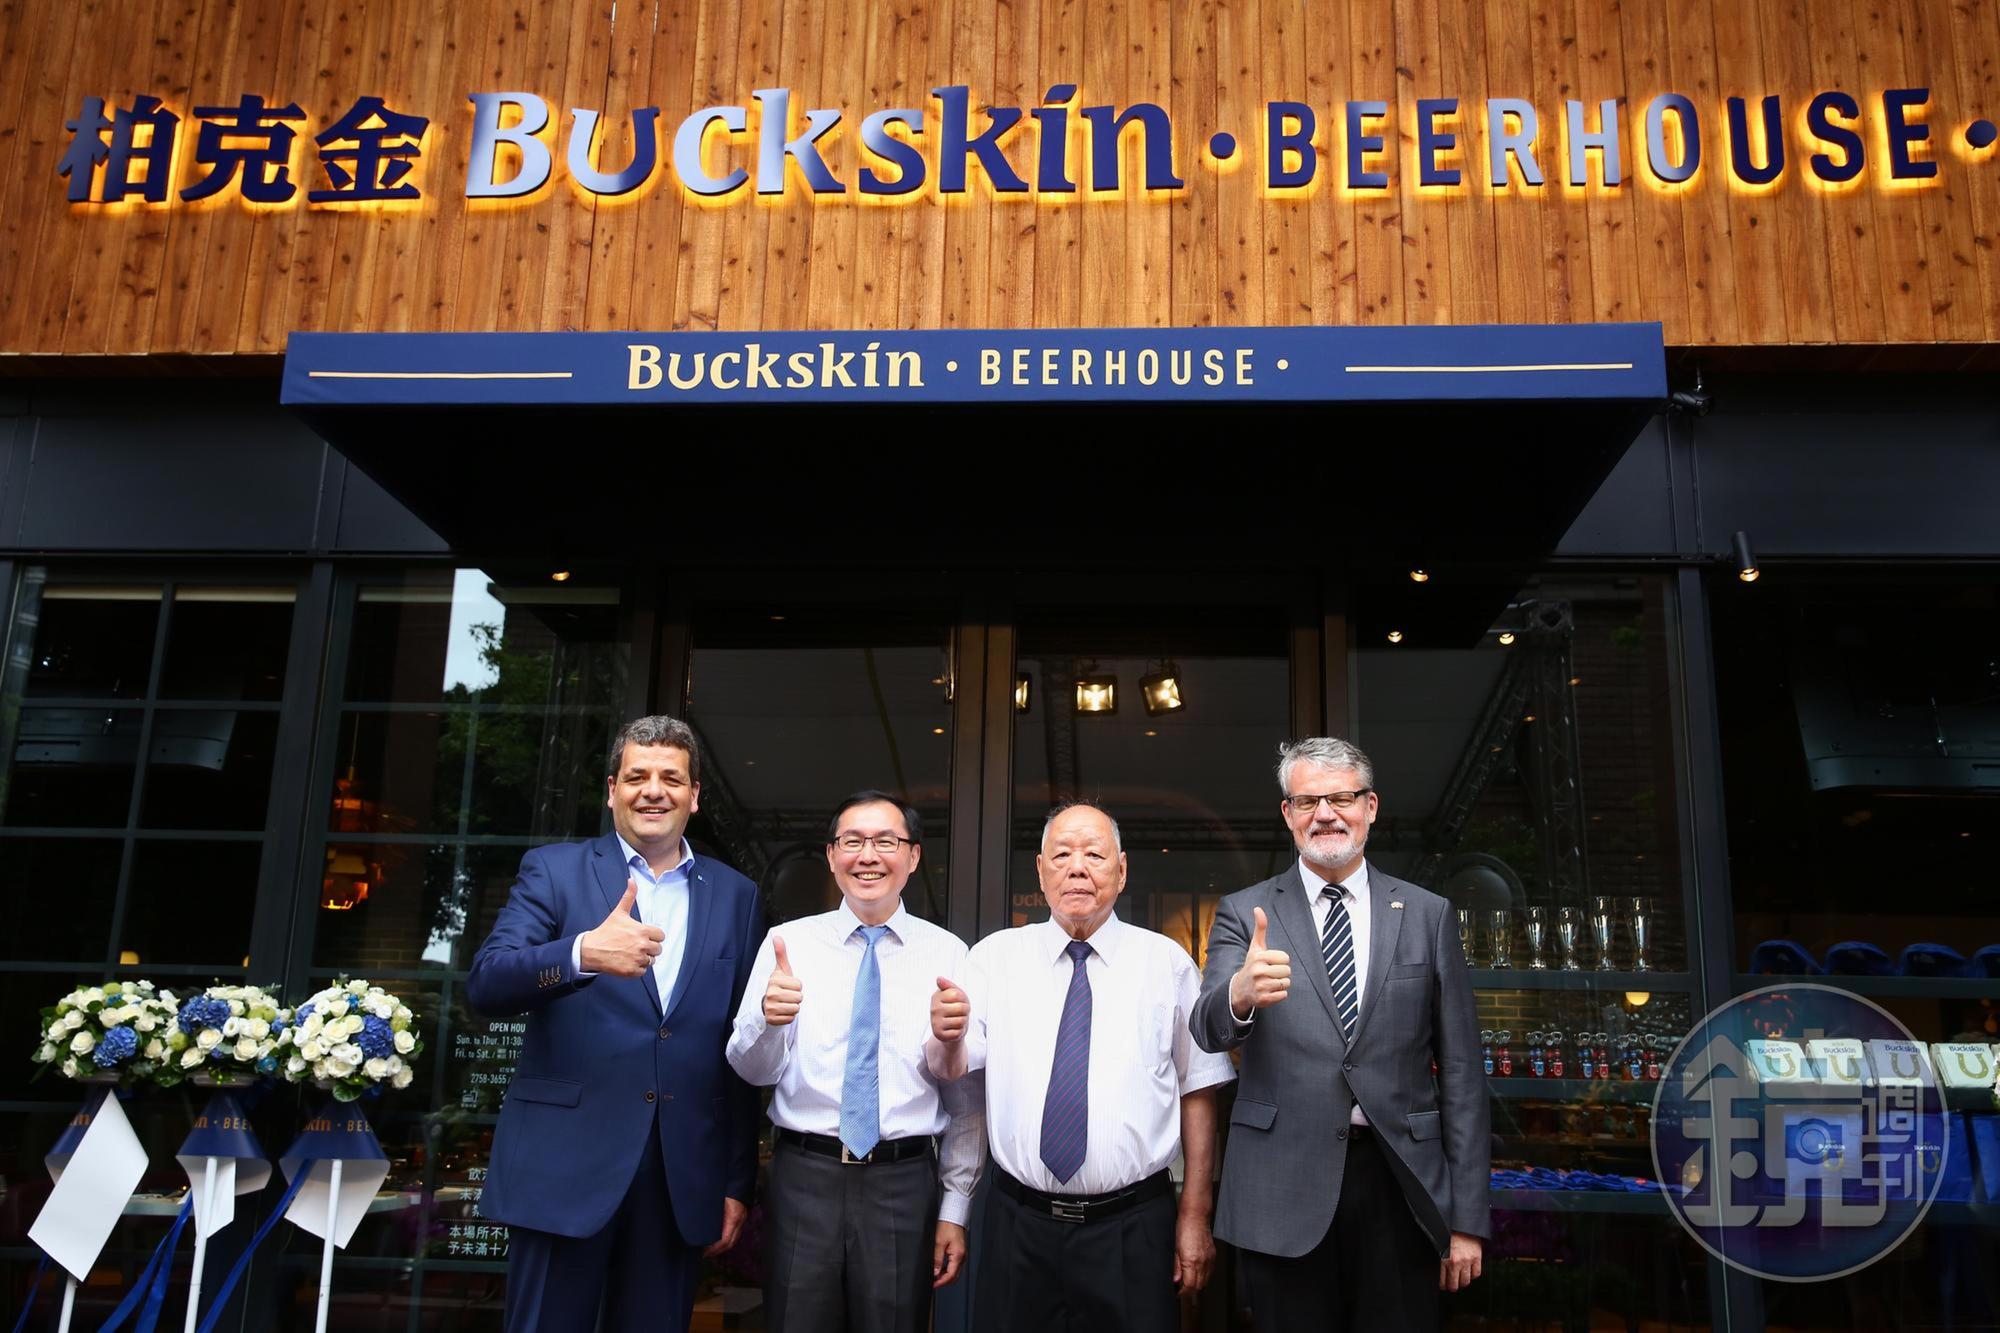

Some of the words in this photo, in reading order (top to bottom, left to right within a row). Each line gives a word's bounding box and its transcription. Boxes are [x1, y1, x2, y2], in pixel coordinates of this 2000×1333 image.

[1267, 88, 1938, 188] BEERHOUSE
[57, 94, 430, 202] 柏克金
[980, 348, 1254, 386] BEERHOUSE
[489, 1022, 509, 1032] OPEN
[510, 1023, 526, 1033] HOU
[456, 1034, 472, 1045] Sun.
[482, 1035, 500, 1046] Thur.
[502, 1036, 523, 1046] 11:30
[455, 1048, 466, 1058] Fri.
[476, 1048, 491, 1059] Sat.
[223, 1116, 252, 1130] BEE
[346, 1119, 373, 1132] BEE
